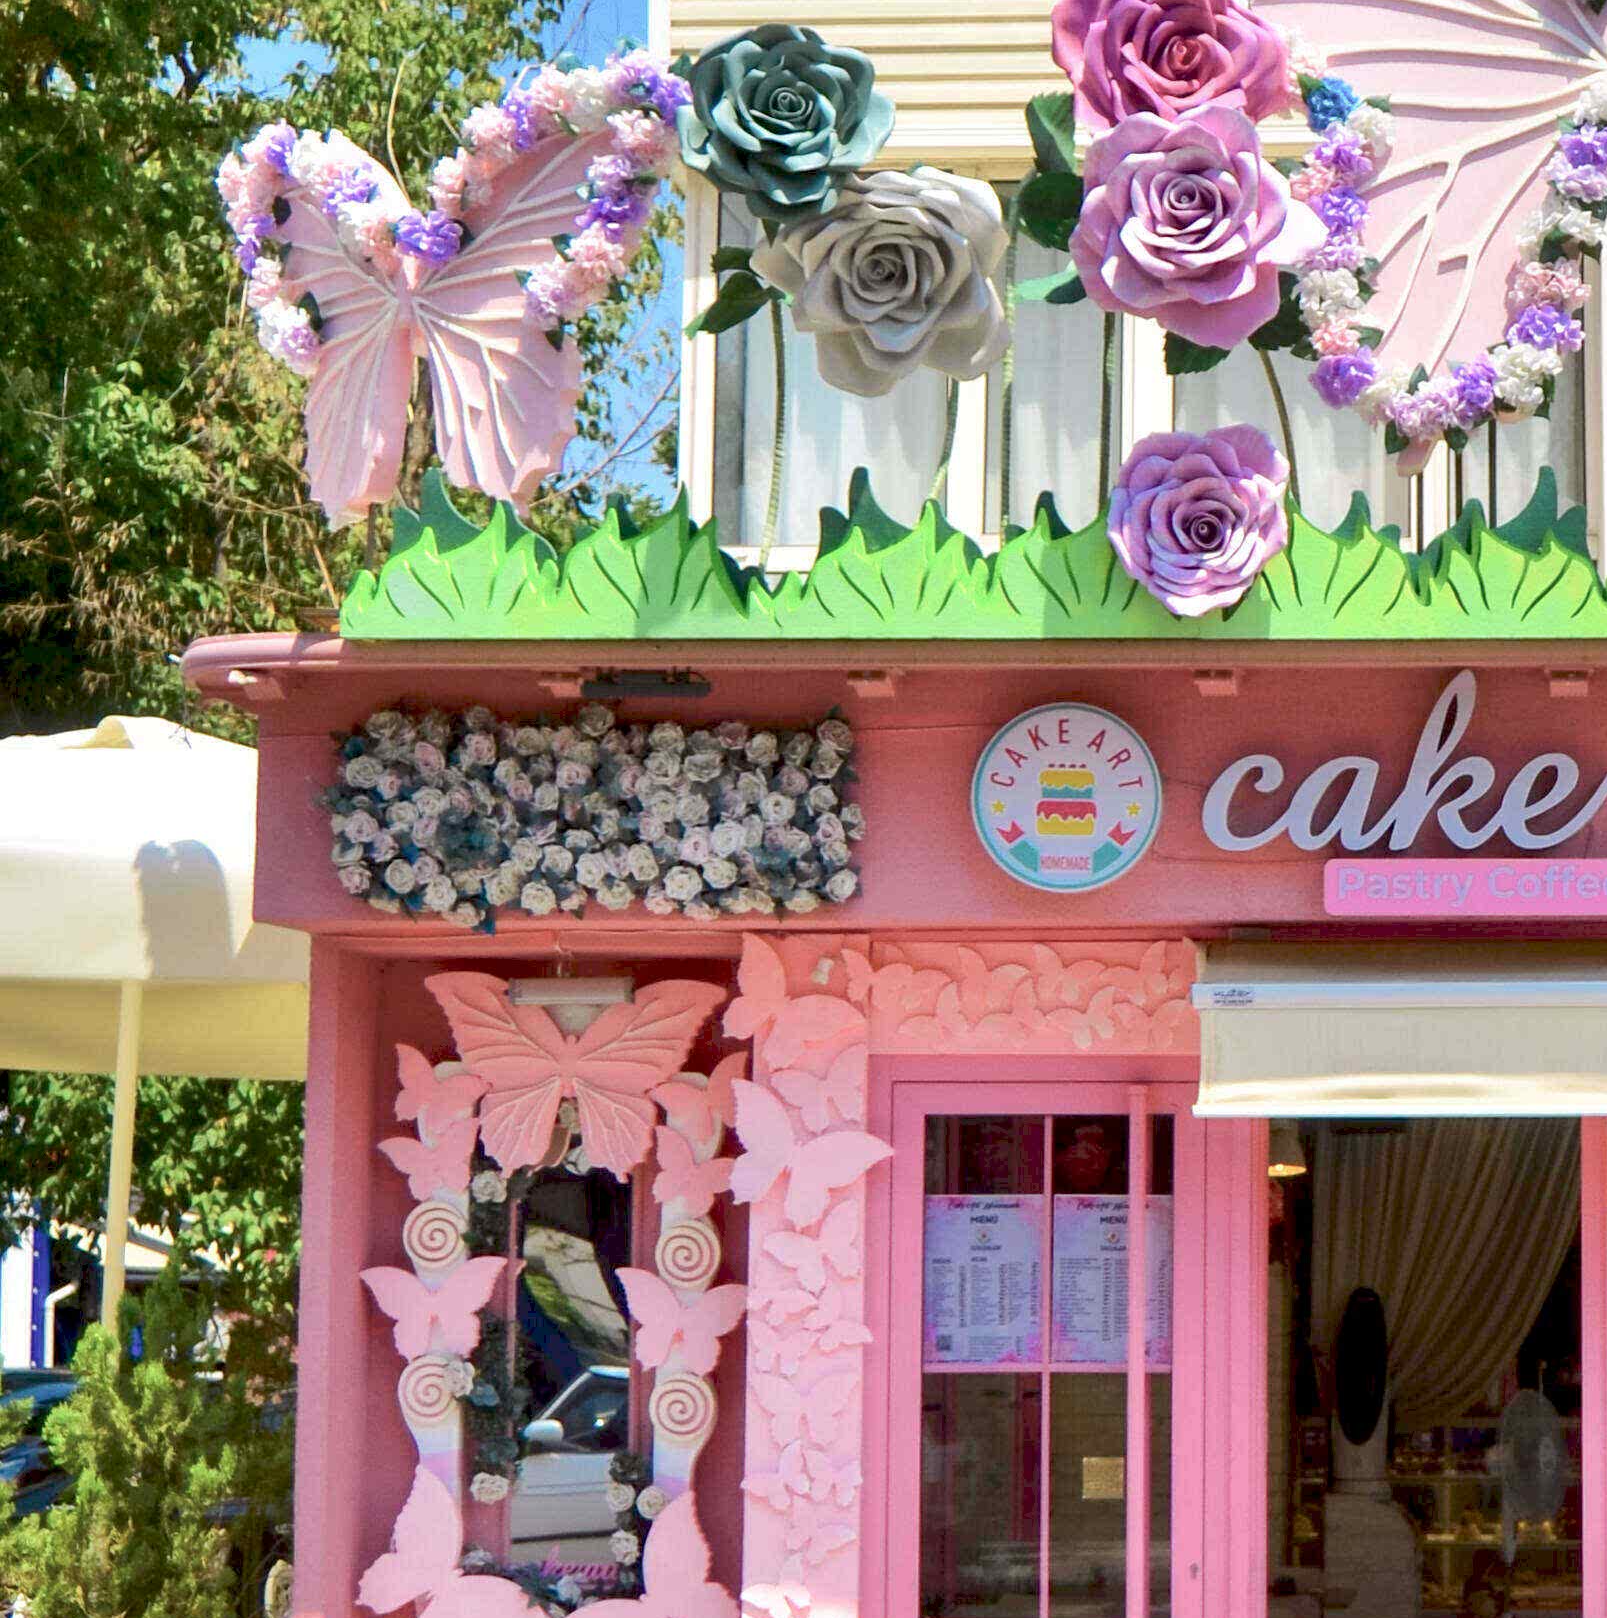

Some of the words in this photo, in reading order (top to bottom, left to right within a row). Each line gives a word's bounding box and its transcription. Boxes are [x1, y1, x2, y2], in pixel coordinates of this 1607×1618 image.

[990, 718, 1071, 788] CAKE
[1087, 729, 1144, 788] ART
[1040, 856, 1091, 871] HOMEMADE
[1336, 866, 1475, 908] Pastry
